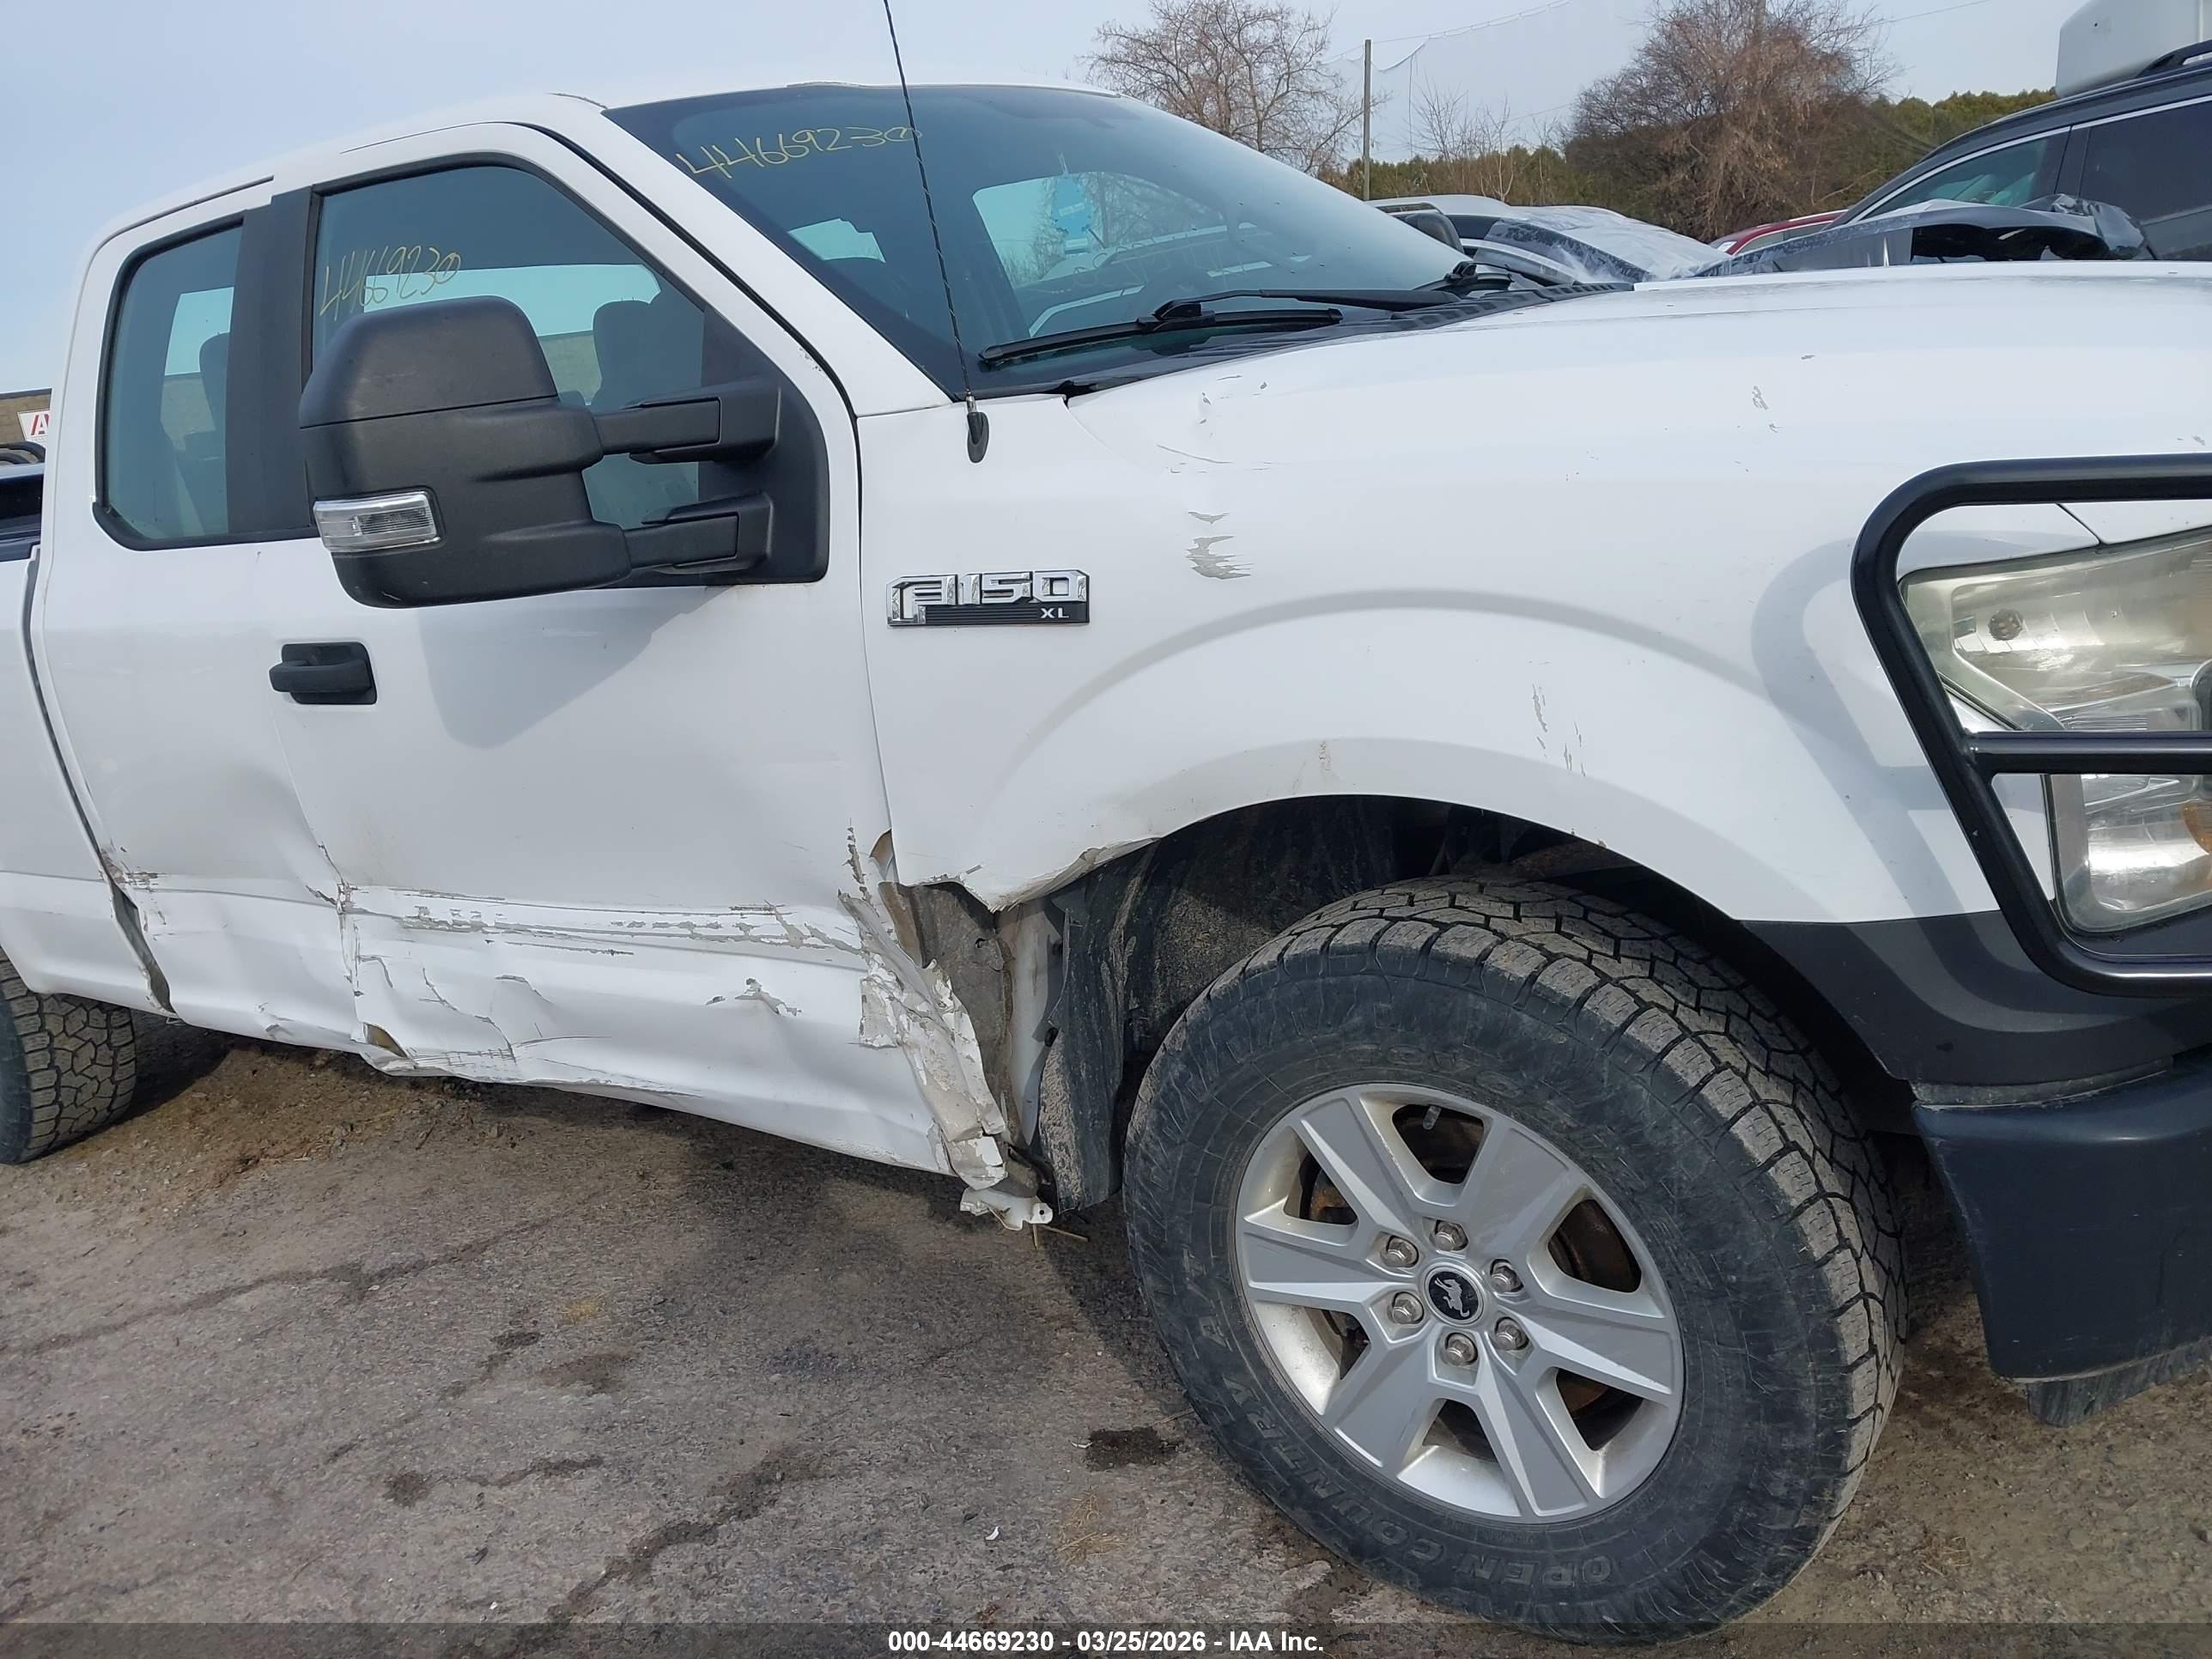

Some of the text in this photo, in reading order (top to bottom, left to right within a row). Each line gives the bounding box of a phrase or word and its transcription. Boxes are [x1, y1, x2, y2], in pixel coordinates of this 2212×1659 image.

[676, 126, 922, 179] 44669230
[319, 246, 461, 322] 44669230
[886, 569, 1090, 625] F150
[1040, 608, 1070, 618] XL
[1456, 1553, 1614, 1590] OPEN
